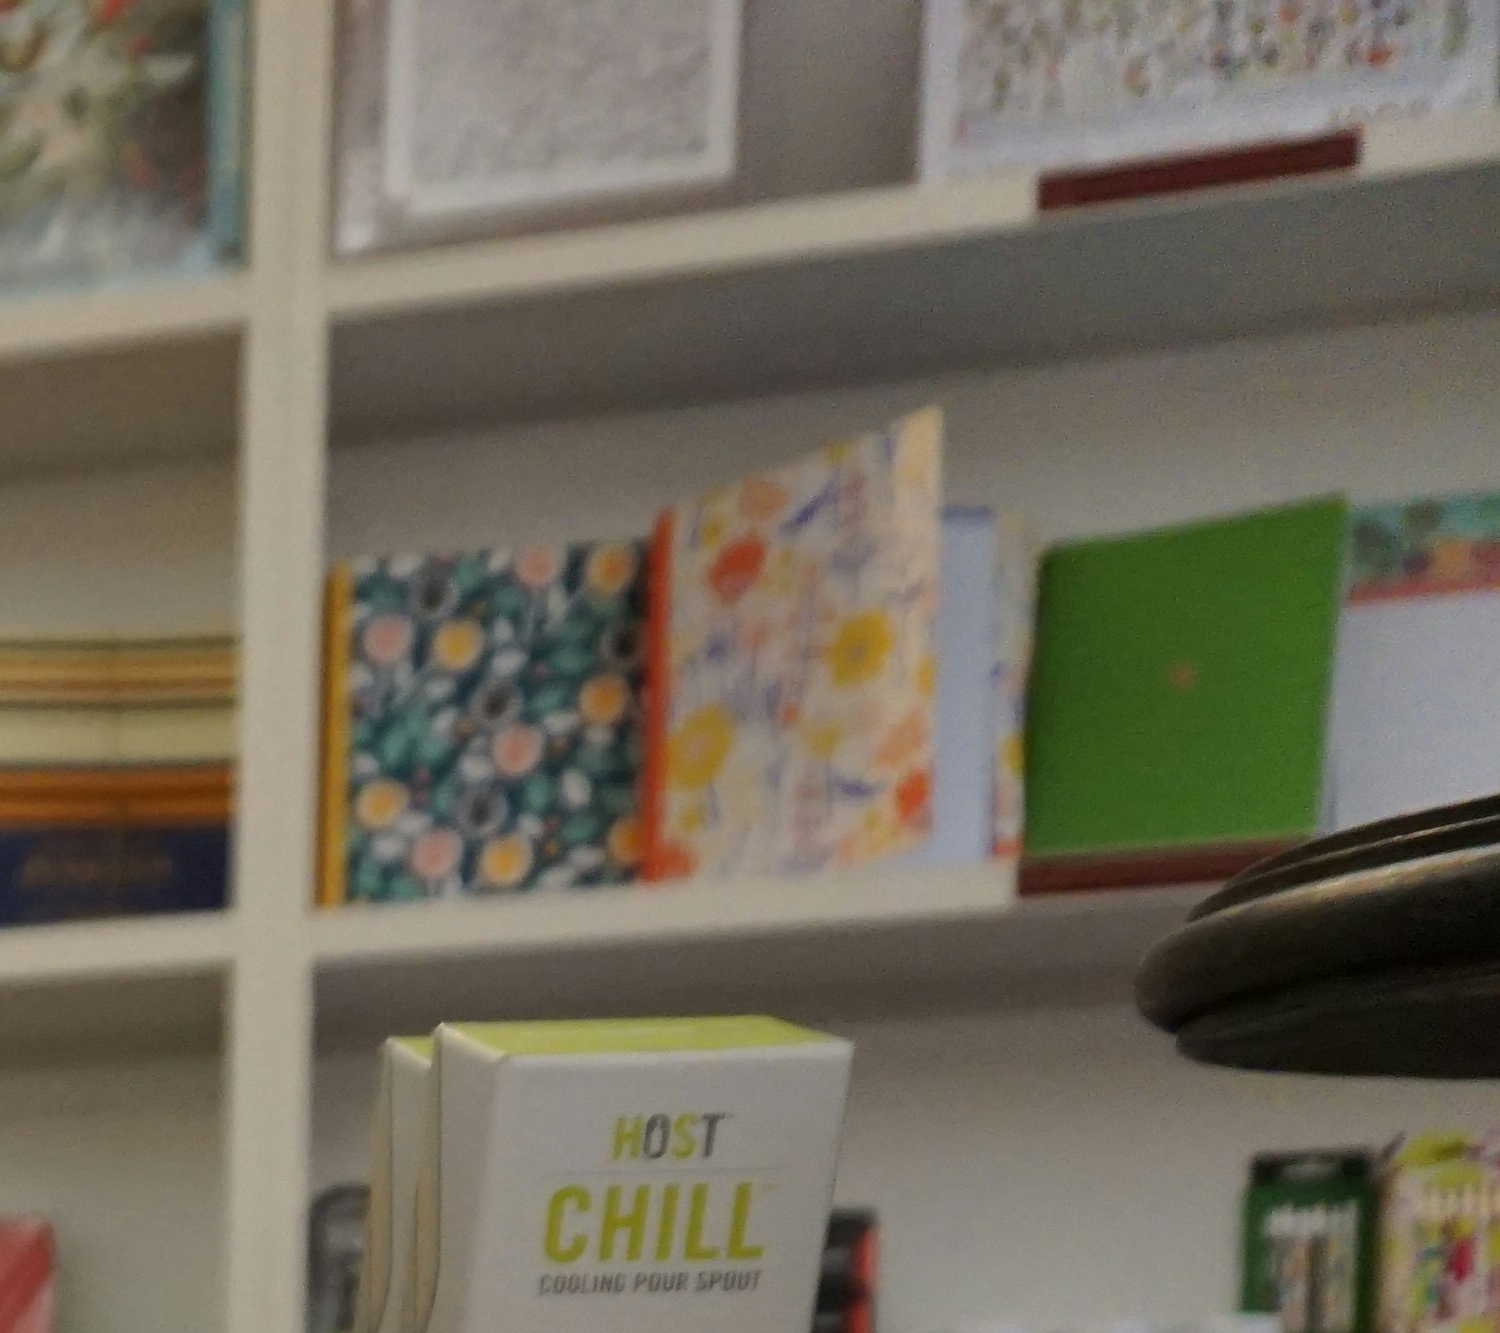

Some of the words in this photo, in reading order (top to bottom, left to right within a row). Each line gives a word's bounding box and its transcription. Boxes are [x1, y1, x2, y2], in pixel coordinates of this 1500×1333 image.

[610, 1112, 732, 1160] HOST
[543, 1181, 768, 1265] CHILL
[537, 1270, 628, 1297] COOLING
[634, 1270, 690, 1294] POUR
[695, 1268, 763, 1293] SPOUT
